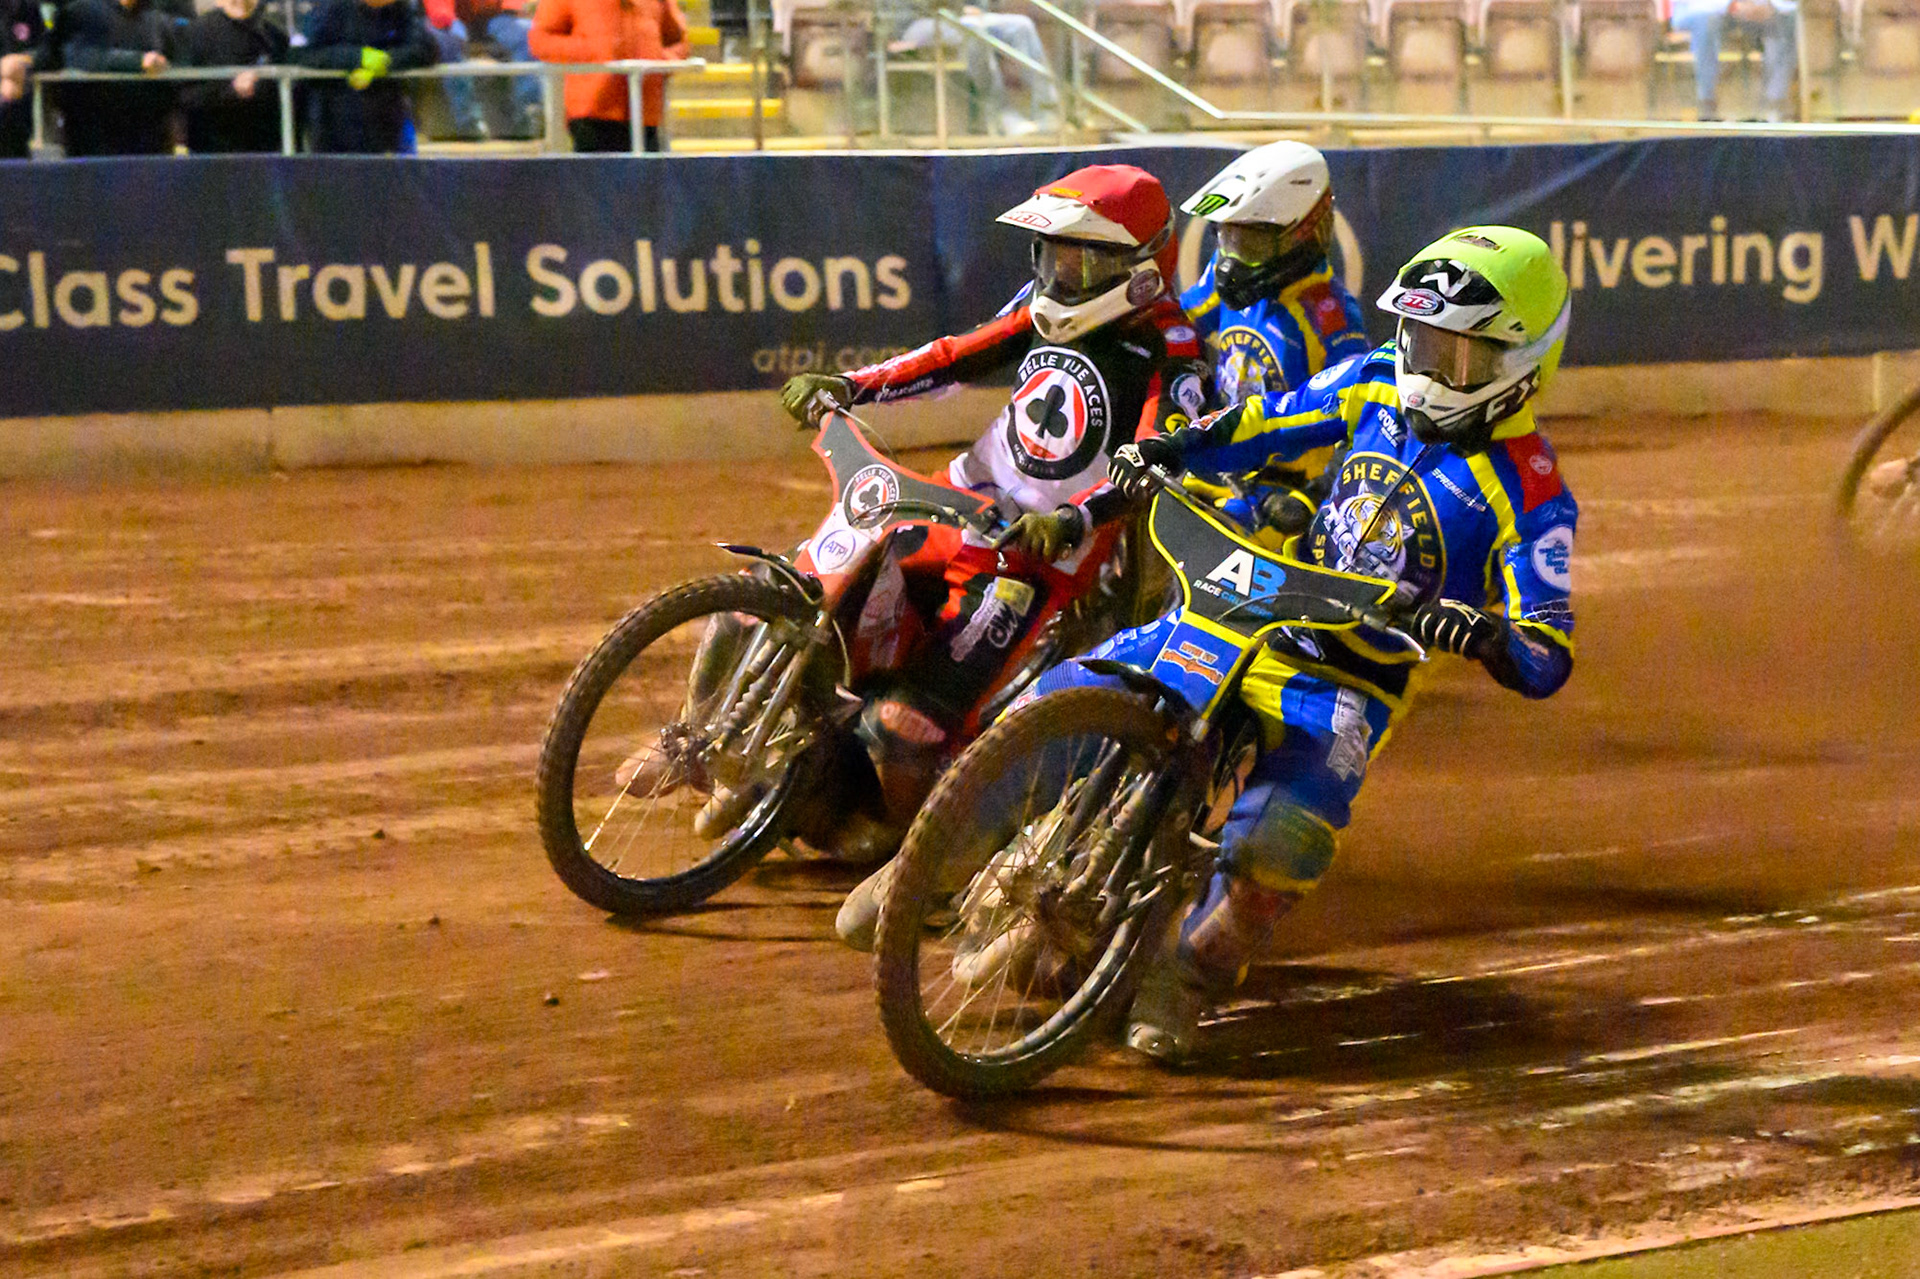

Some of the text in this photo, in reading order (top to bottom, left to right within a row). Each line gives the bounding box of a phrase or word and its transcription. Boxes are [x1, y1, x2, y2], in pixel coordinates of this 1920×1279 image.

[225, 241, 496, 322] Travel
[526, 238, 912, 318] Solutions
[1401, 293, 1434, 309] STS
[1019, 354, 1104, 427] BELLE VUE ACES
[1377, 407, 1405, 438] ROW
[1342, 462, 1437, 569] SHEFFIELD
[1205, 548, 1287, 604] AB
